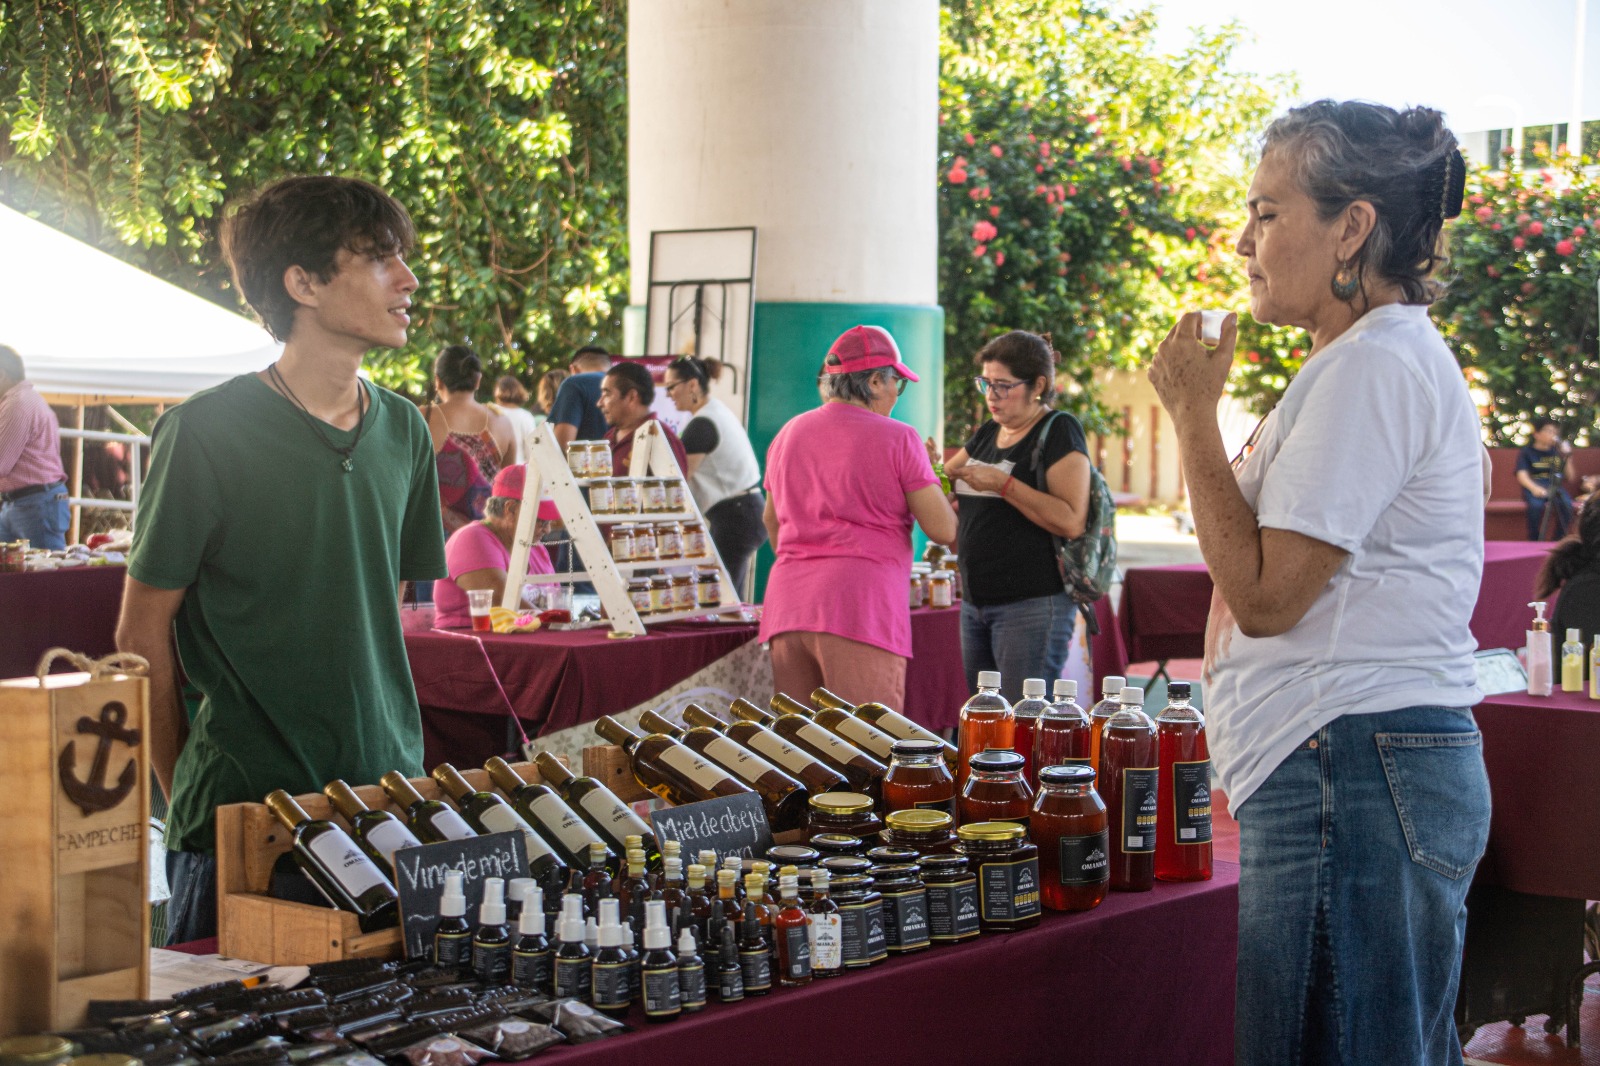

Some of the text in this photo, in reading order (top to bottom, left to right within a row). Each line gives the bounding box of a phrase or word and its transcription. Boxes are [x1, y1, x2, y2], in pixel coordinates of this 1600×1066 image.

[656, 803, 766, 843] Miel de abeja
[480, 837, 520, 877] miel
[903, 922, 927, 932] OMANKAL
